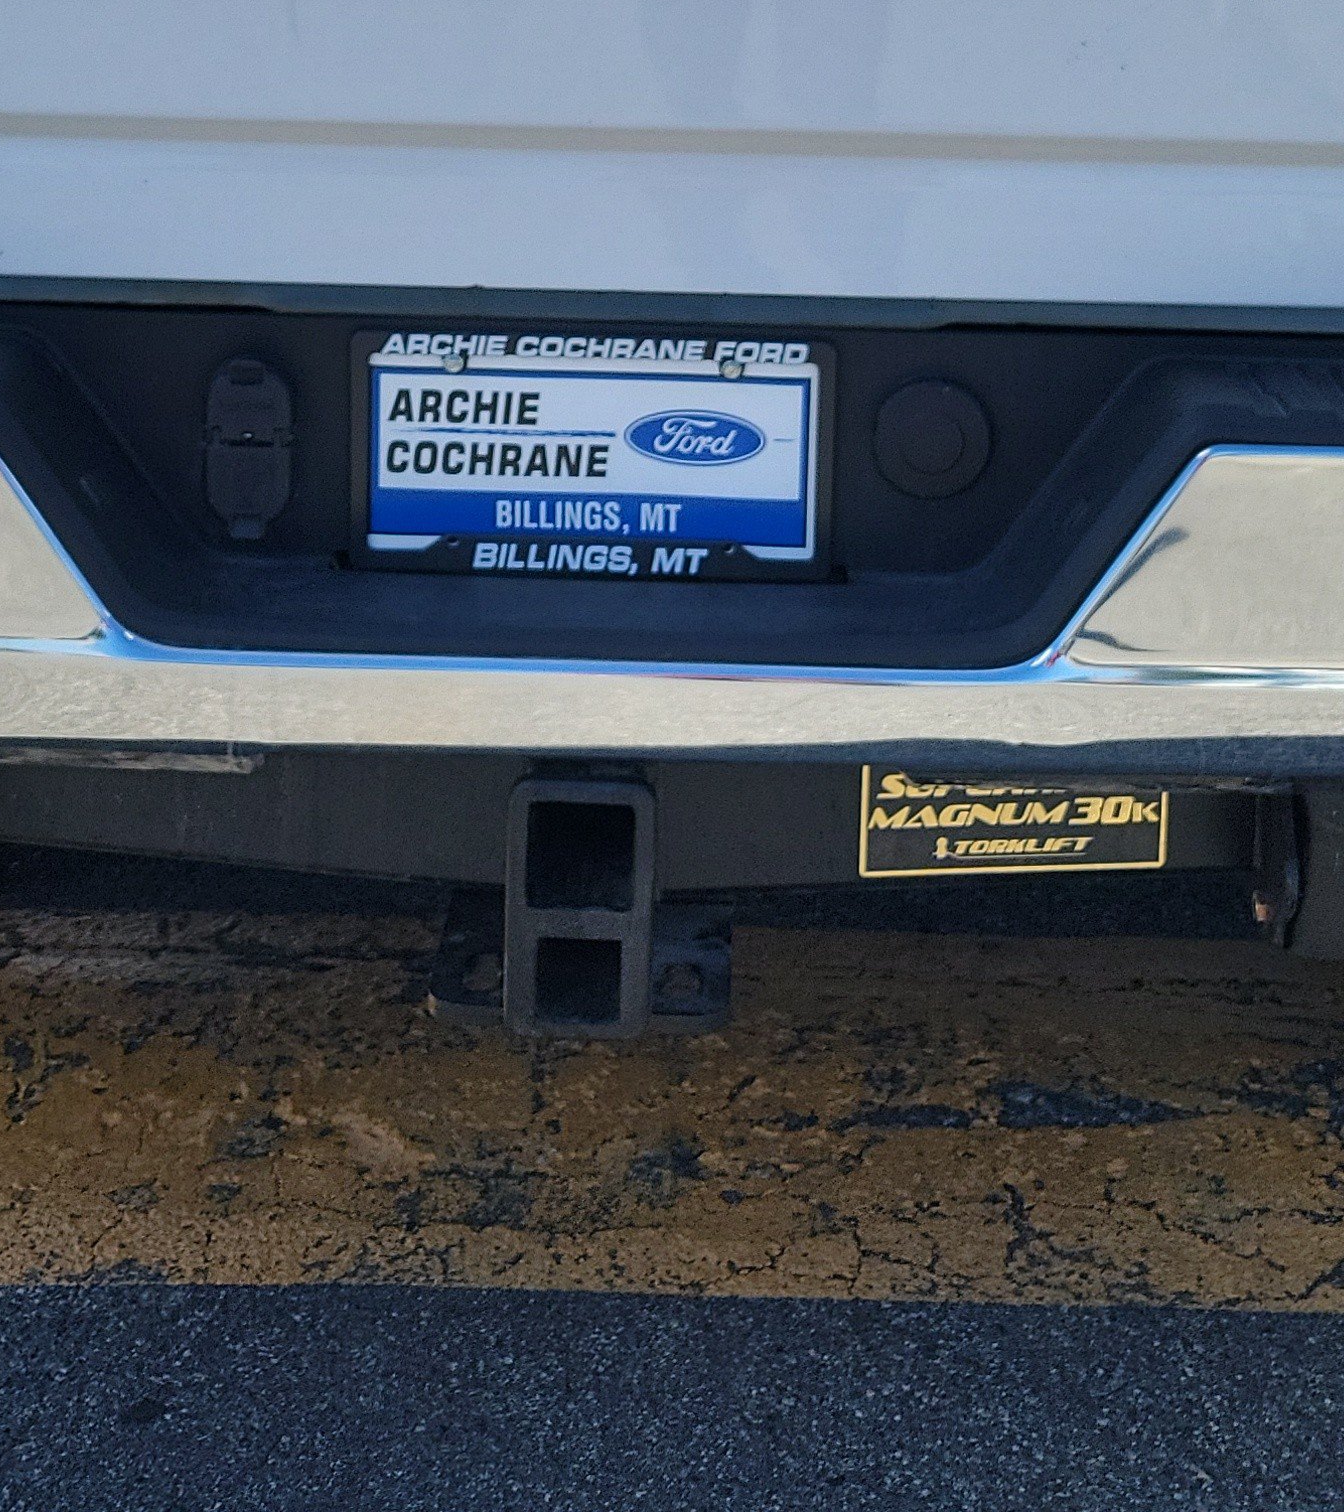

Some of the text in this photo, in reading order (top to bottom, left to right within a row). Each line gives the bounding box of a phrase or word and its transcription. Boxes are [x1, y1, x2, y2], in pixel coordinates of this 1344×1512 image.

[381, 333, 810, 365] ARCHIE COCHRANE FORD
[387, 388, 541, 426] ARCHIE
[652, 416, 737, 456] Ford
[385, 439, 611, 478] COCHRANE
[494, 499, 683, 535] BILLINGS, MT
[471, 541, 709, 575] BILLINGS, MT
[868, 801, 1070, 830] MAGNUM
[952, 835, 1094, 855] TORKLIFT
